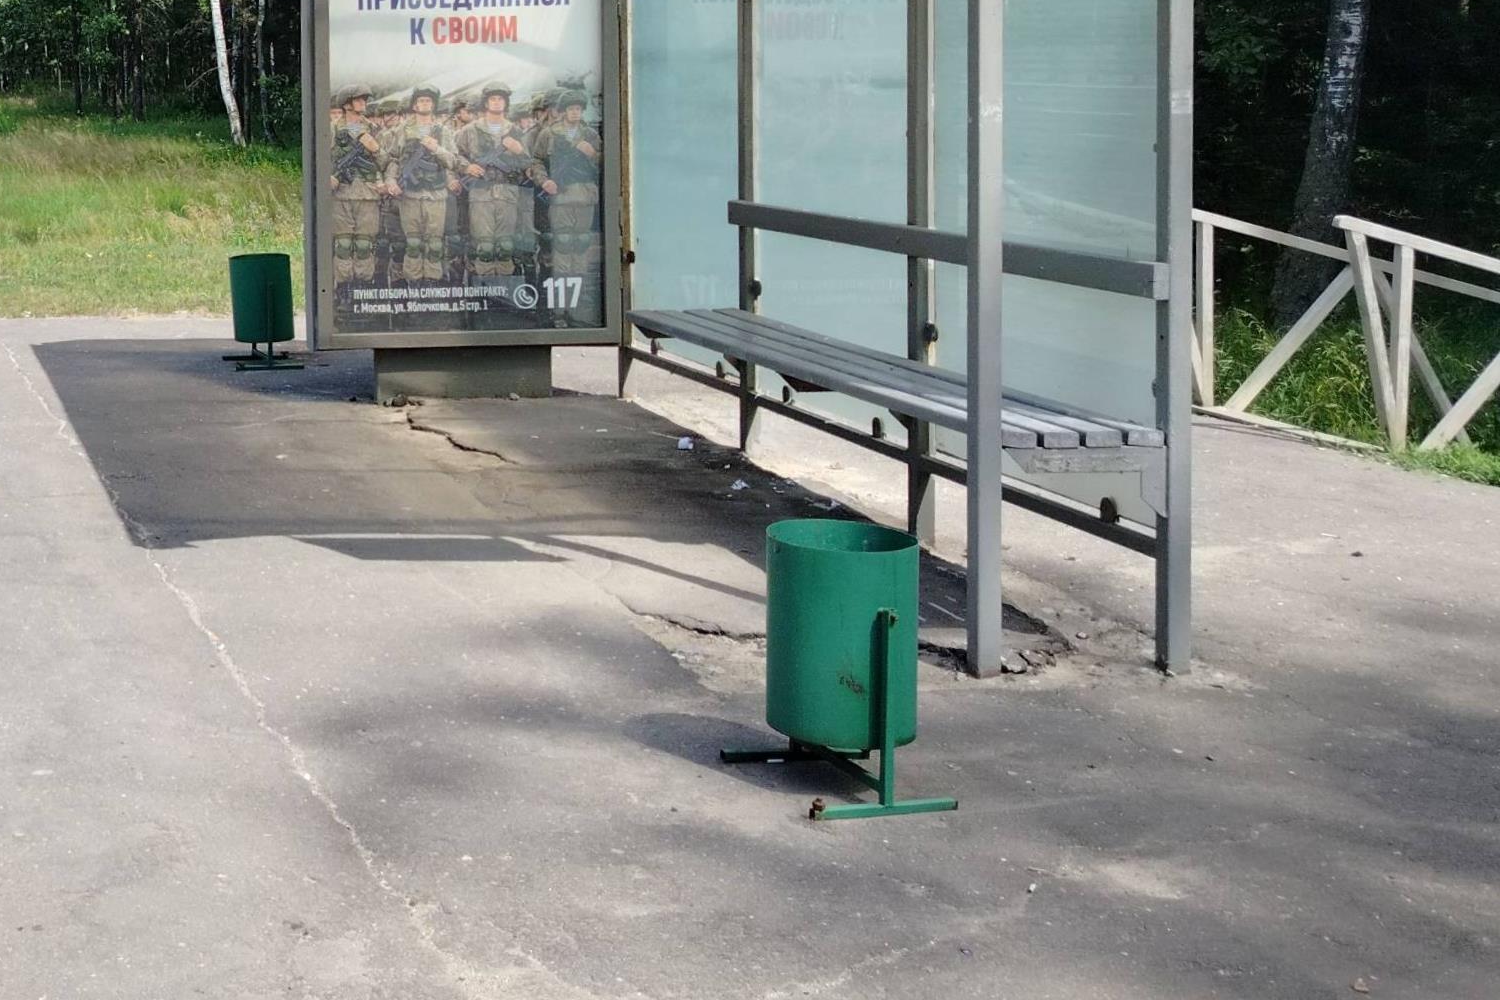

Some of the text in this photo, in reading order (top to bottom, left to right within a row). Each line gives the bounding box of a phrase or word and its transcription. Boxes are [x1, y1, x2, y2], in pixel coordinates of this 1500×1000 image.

[410, 15, 518, 45] К СВОИМ
[353, 289, 378, 299] ПУНКТ
[379, 288, 408, 299] ОТБОРА
[408, 288, 420, 298] НА
[420, 287, 451, 298] СЛУЖБУ
[452, 286, 463, 297] ПО
[543, 277, 583, 309] 117
[353, 304, 360, 314] г.
[394, 303, 406, 314] ул.
[466, 301, 482, 313] стр.
[483, 299, 488, 310] 1
